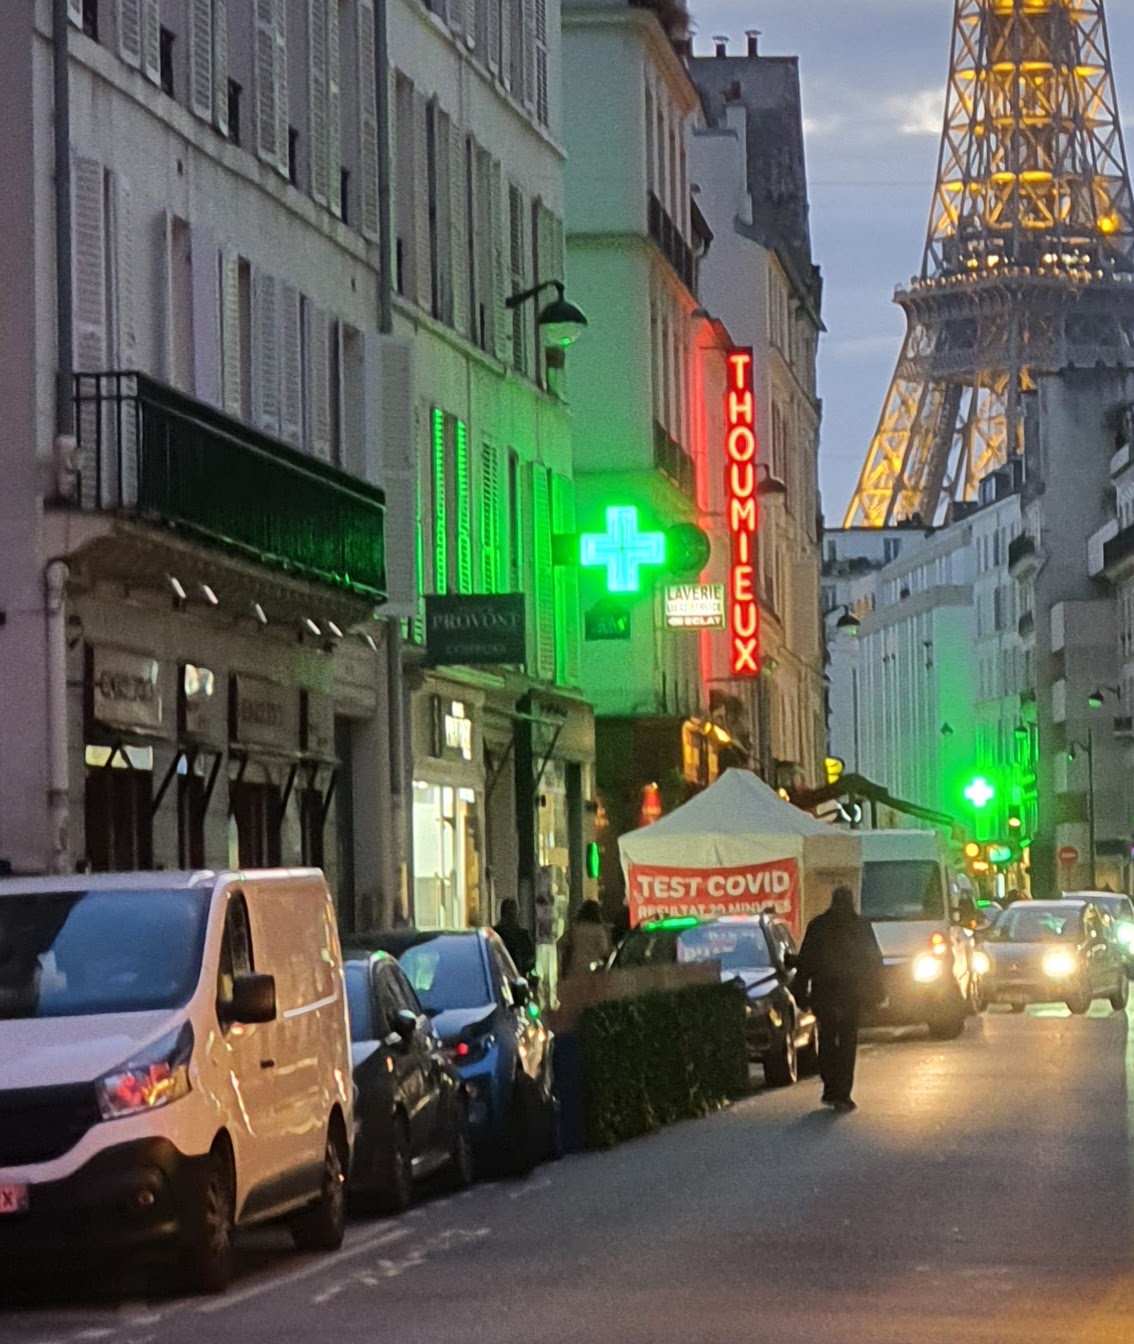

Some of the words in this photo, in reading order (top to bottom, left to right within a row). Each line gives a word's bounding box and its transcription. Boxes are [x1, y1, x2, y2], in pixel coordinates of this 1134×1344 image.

[727, 354, 758, 672] THOUMIEUX
[667, 586, 722, 601] LAVERIE
[637, 874, 703, 899] TEST
[706, 869, 791, 898] COVID
